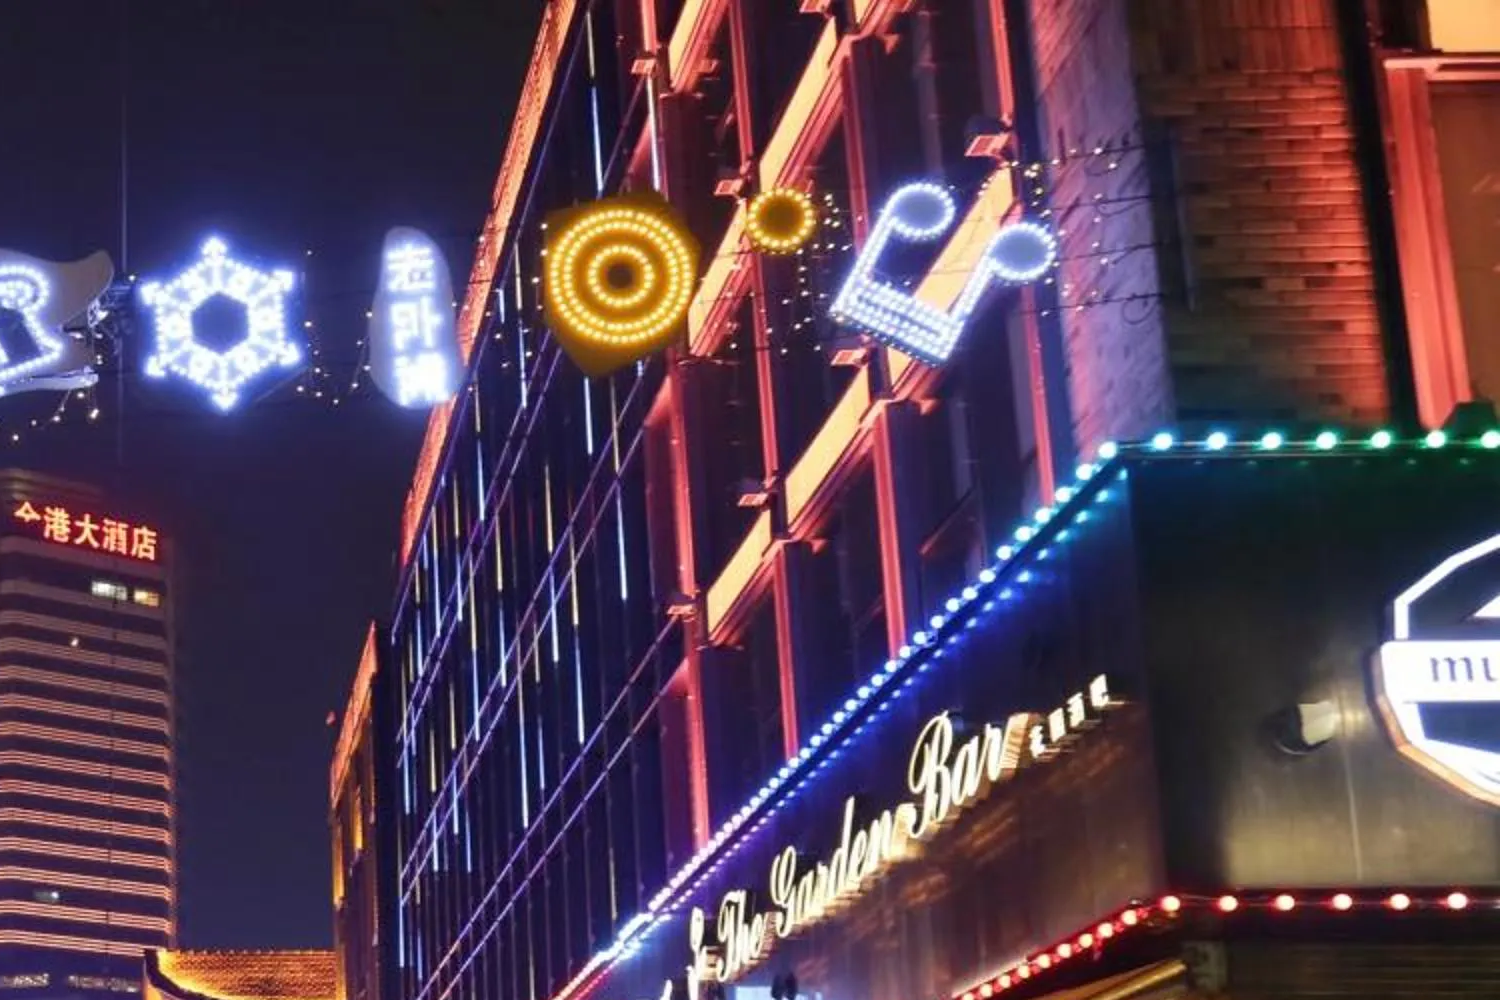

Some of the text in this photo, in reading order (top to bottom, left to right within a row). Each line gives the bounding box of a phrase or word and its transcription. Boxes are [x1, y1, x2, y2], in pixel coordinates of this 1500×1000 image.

[717, 889, 766, 983] The
[771, 796, 903, 938] Garden
[908, 710, 1018, 838] Bar
